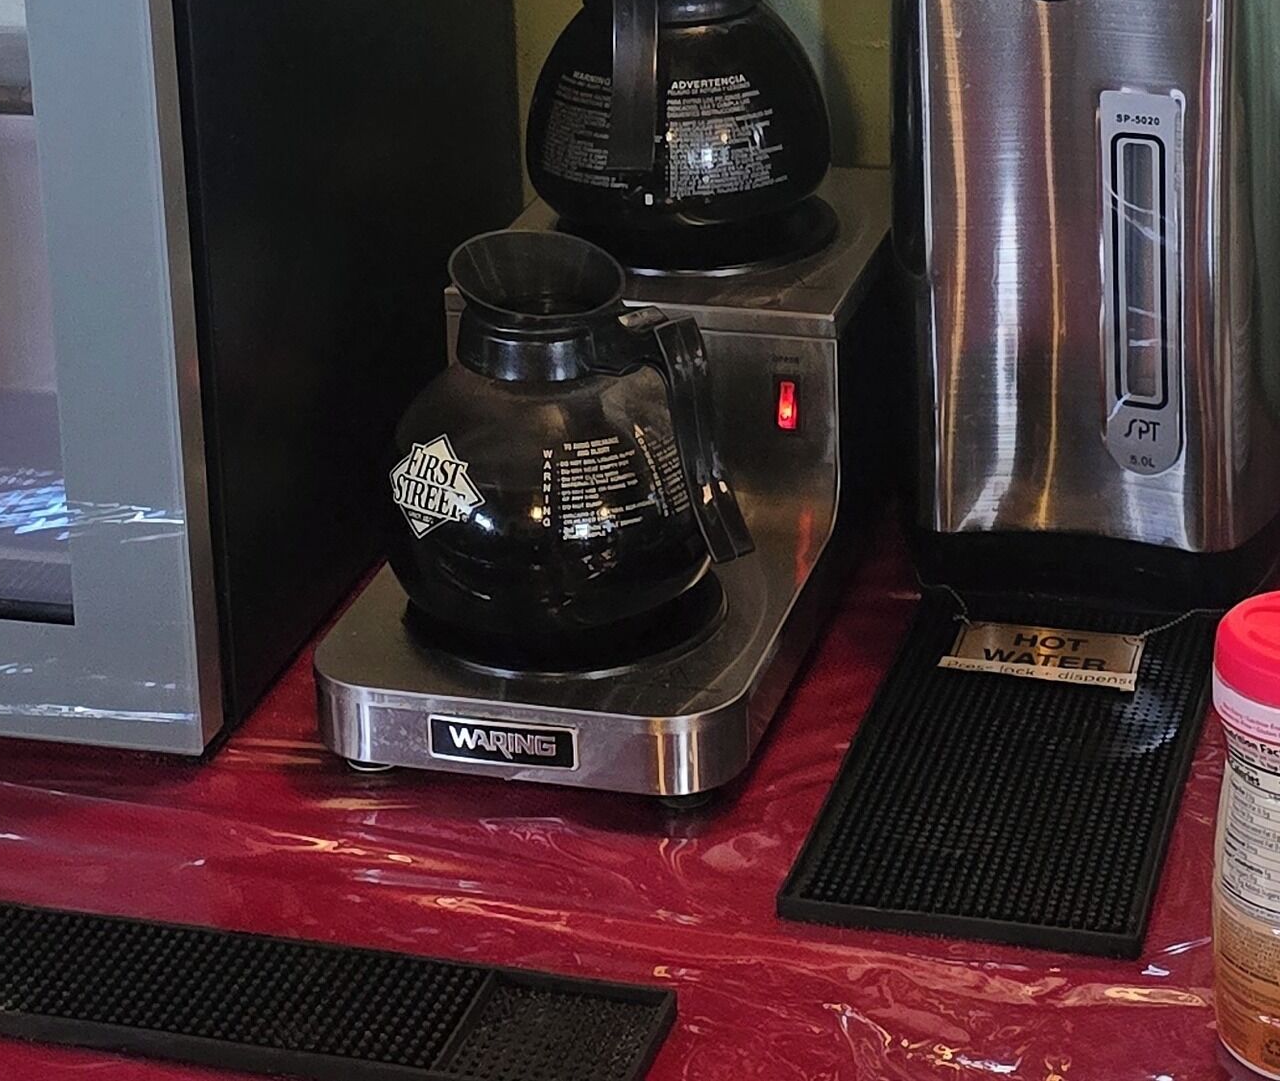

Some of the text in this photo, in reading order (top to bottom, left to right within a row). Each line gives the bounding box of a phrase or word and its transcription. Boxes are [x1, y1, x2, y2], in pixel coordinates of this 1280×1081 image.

[671, 74, 747, 91] ADVERTENCIA
[1124, 418, 1161, 442] SPT
[405, 446, 465, 489] FIRST
[542, 449, 554, 527] WARNING
[1013, 633, 1088, 652] HOT
[983, 648, 1107, 671] WATER
[448, 724, 557, 760] WARING
